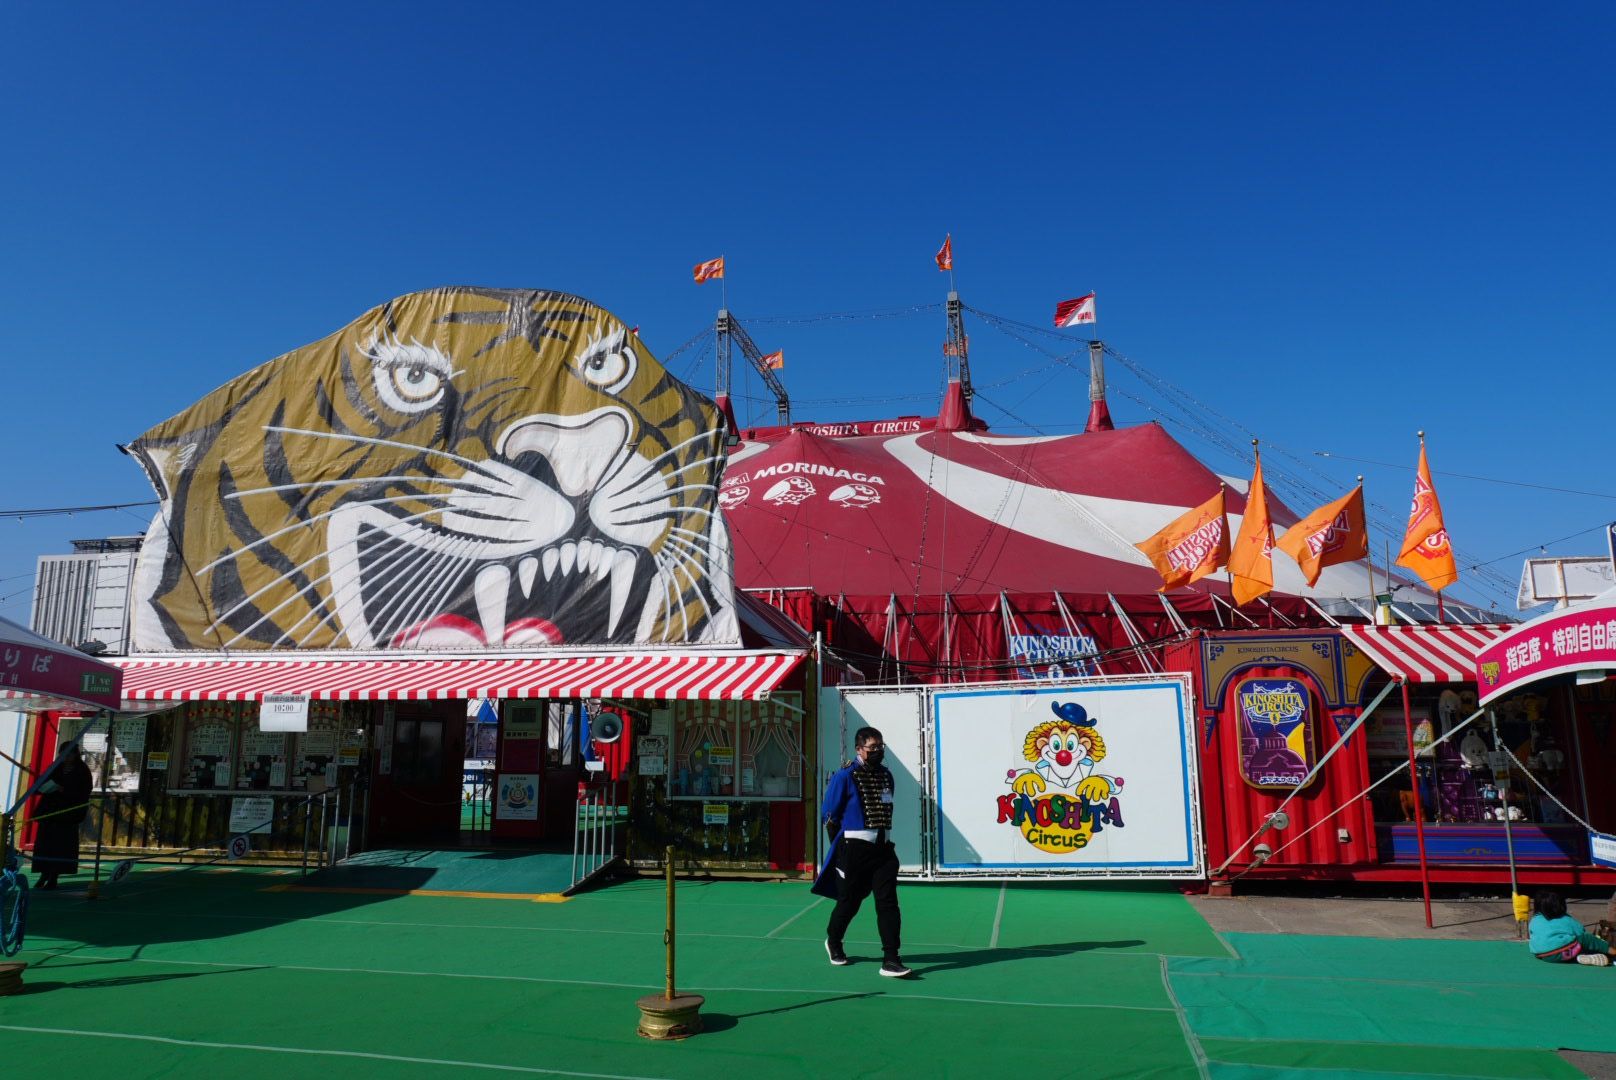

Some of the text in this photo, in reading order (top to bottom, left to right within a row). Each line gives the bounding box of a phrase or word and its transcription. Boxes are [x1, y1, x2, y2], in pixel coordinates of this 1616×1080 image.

[790, 420, 921, 437] NOSHITA CIRCUS
[753, 462, 885, 486] MORINAGA
[1009, 634, 1099, 658] KINOSHITA
[274, 704, 294, 712] 10:00
[1244, 693, 1305, 710] KINOSHITA
[1255, 702, 1294, 714] CIRCUS
[997, 793, 1125, 833] KINOSHITA
[1026, 828, 1089, 849] Circus
